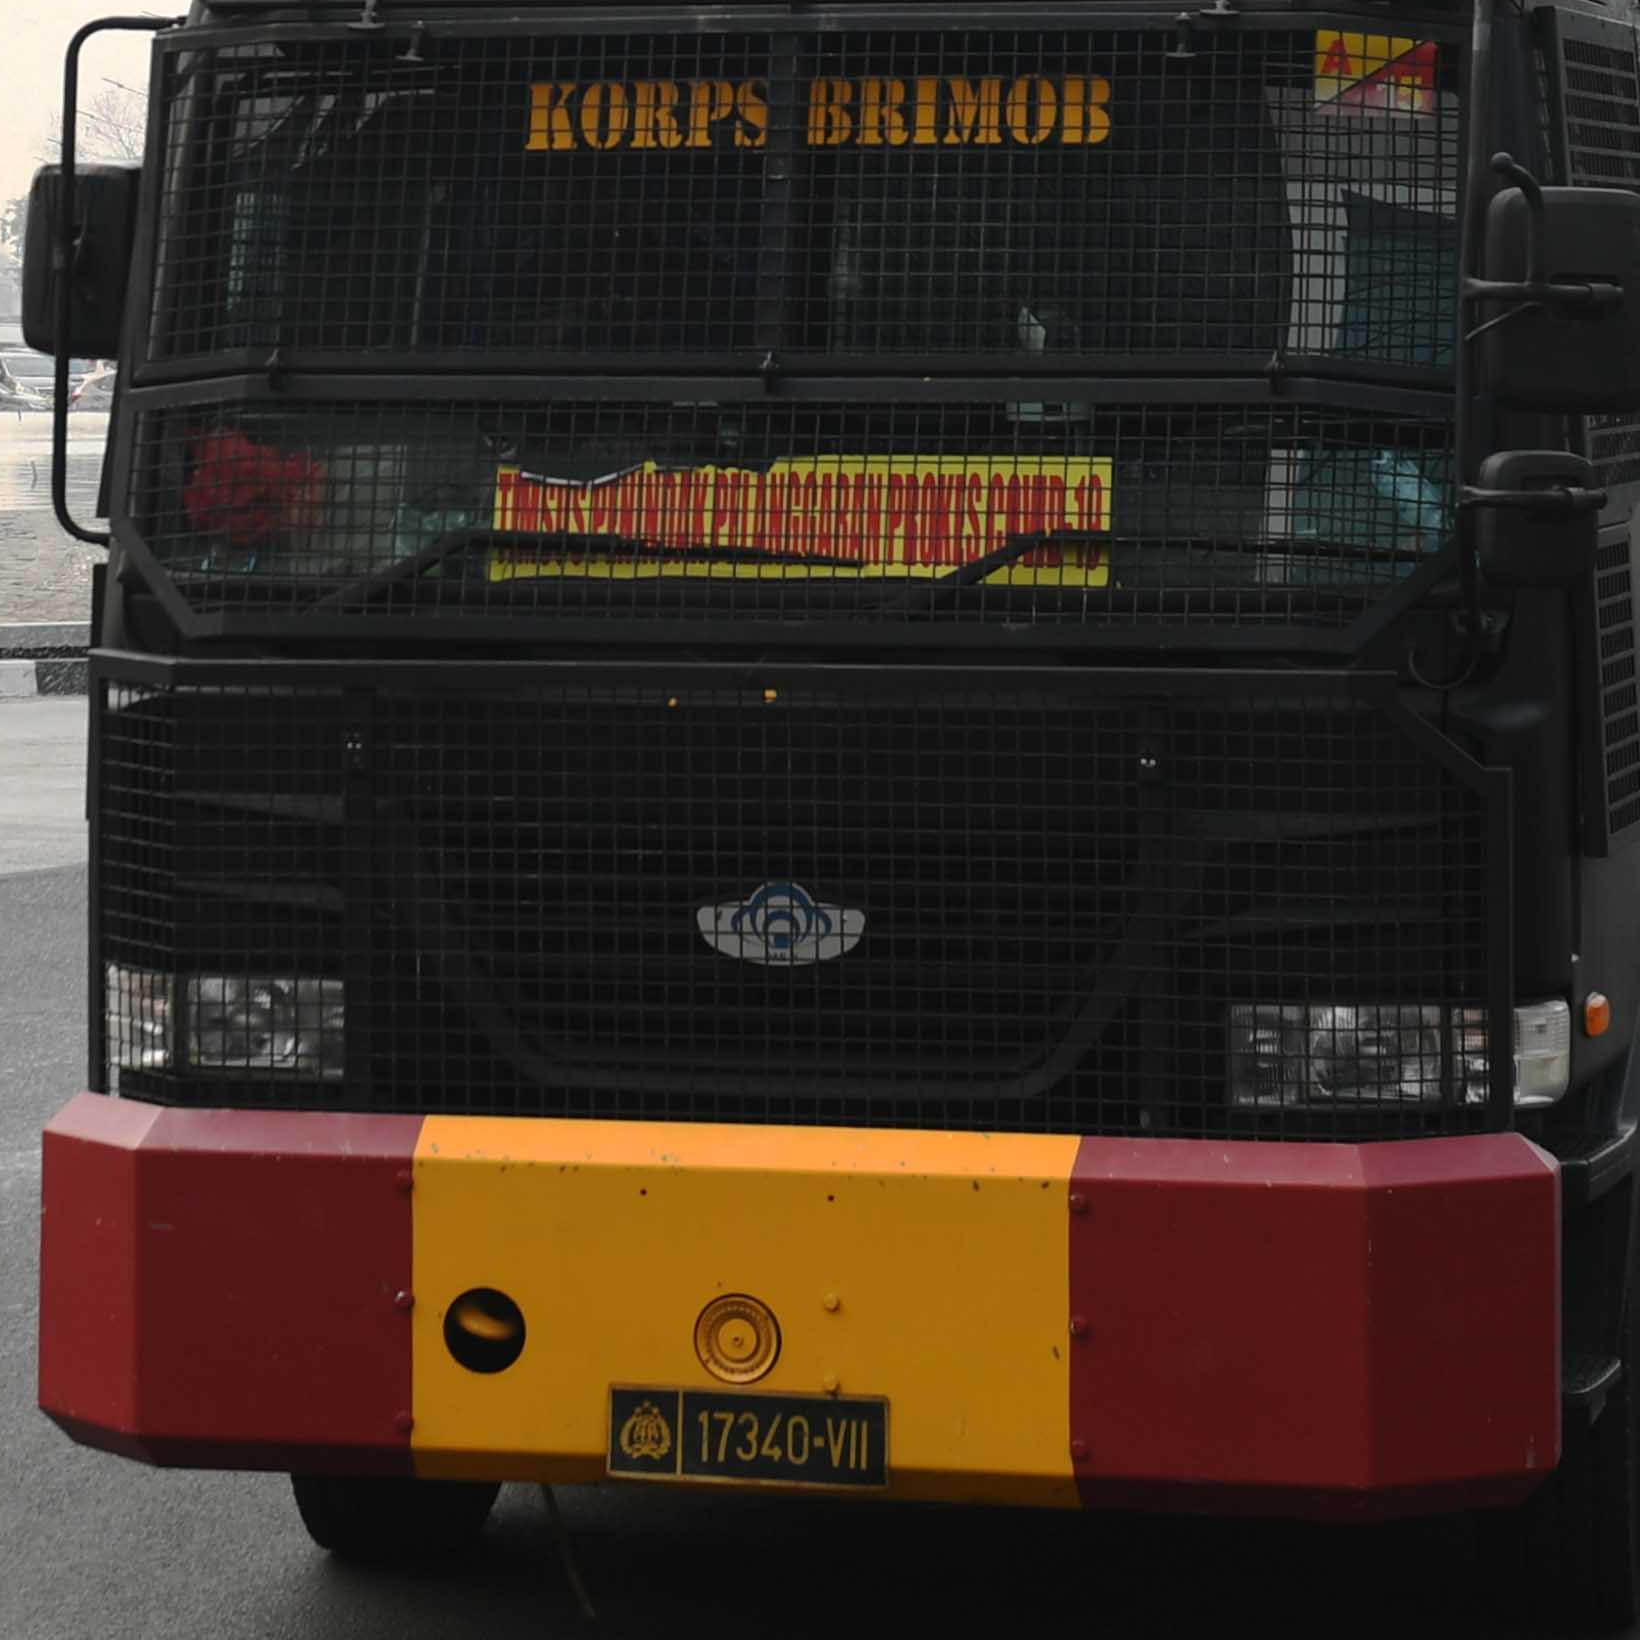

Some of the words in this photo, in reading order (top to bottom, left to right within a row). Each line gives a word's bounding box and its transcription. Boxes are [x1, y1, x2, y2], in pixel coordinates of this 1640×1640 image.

[1320, 38, 1353, 76] A
[524, 81, 769, 151] KORPS
[807, 74, 1112, 146] BRIMOB
[697, 1410, 869, 1471] 17340-VII
